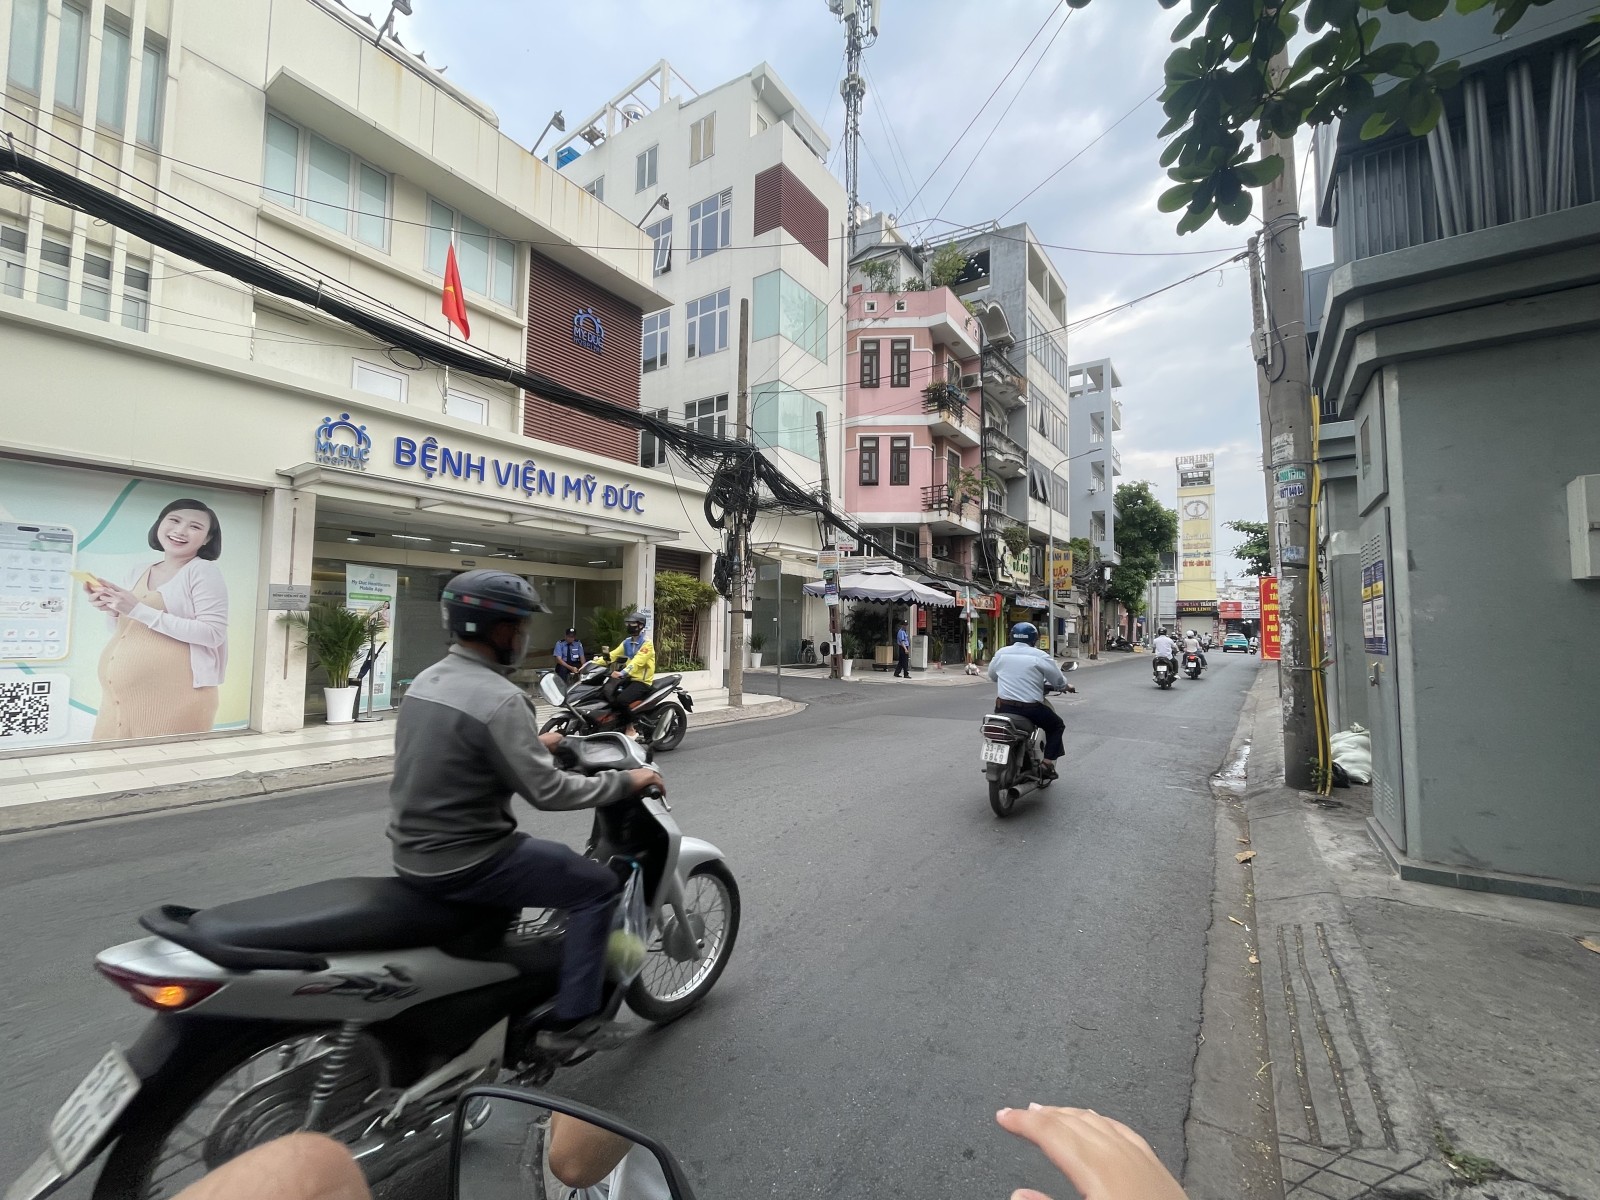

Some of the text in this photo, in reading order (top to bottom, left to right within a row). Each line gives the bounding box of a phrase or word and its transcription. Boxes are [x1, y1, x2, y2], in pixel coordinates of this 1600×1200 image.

[315, 439, 370, 463] MY DUC
[394, 436, 645, 514] BỆNH VIỆN MỸ ĐỨC
